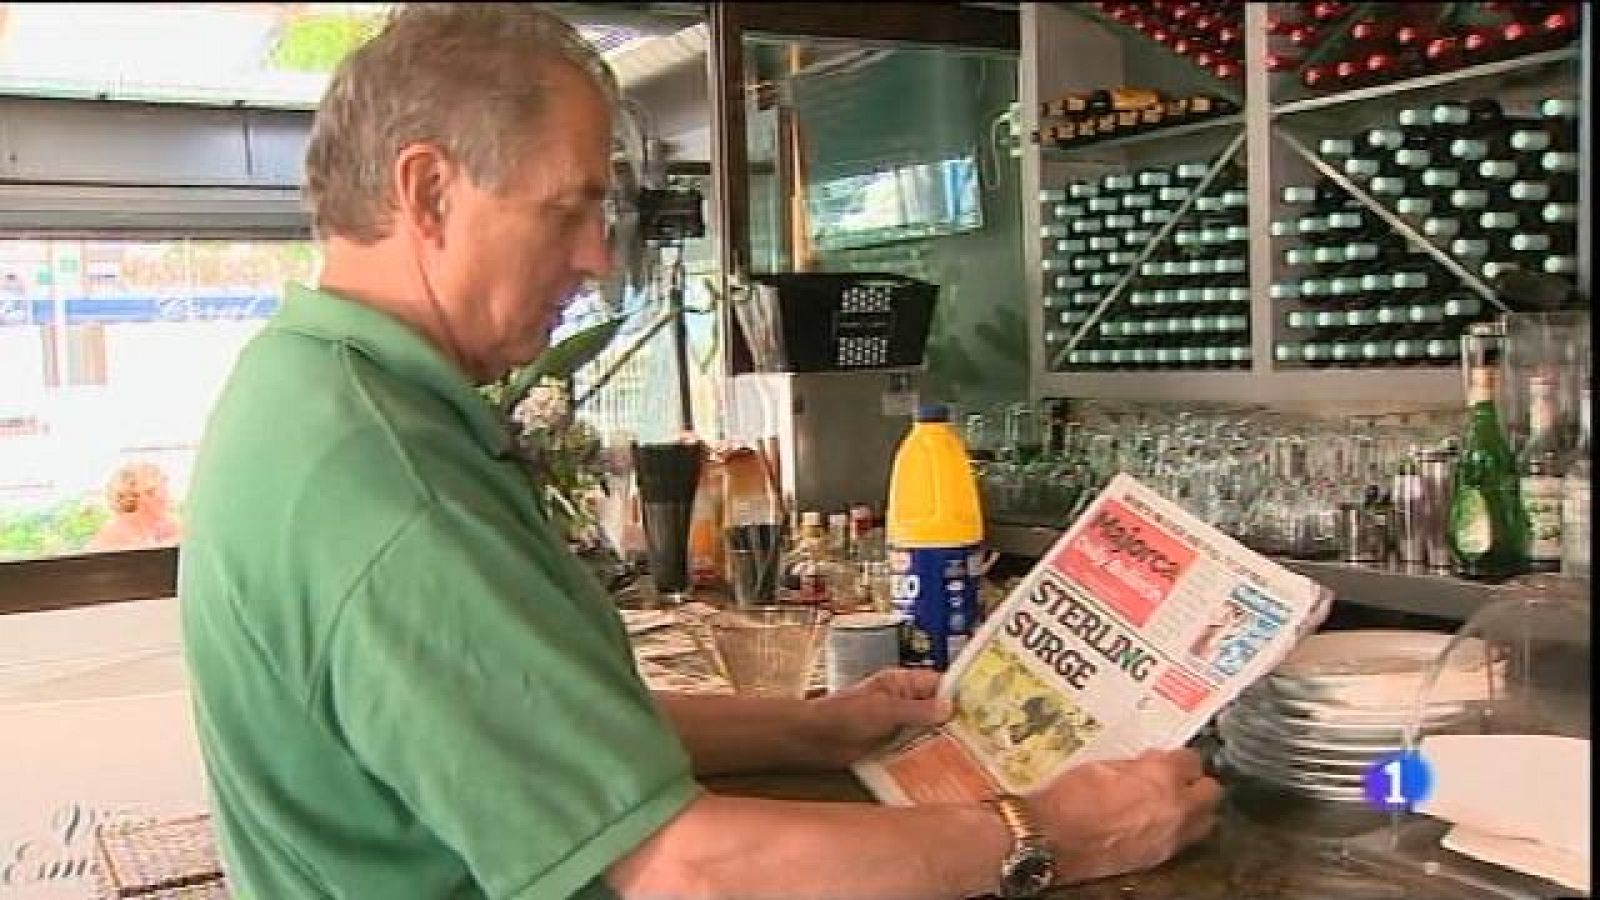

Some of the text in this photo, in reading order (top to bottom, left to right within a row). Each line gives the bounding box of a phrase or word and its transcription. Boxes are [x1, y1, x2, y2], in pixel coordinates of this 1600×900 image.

[1095, 510, 1179, 581] Majorca
[1004, 611, 1098, 690] SURGE
[1031, 579, 1157, 682] STERLING
